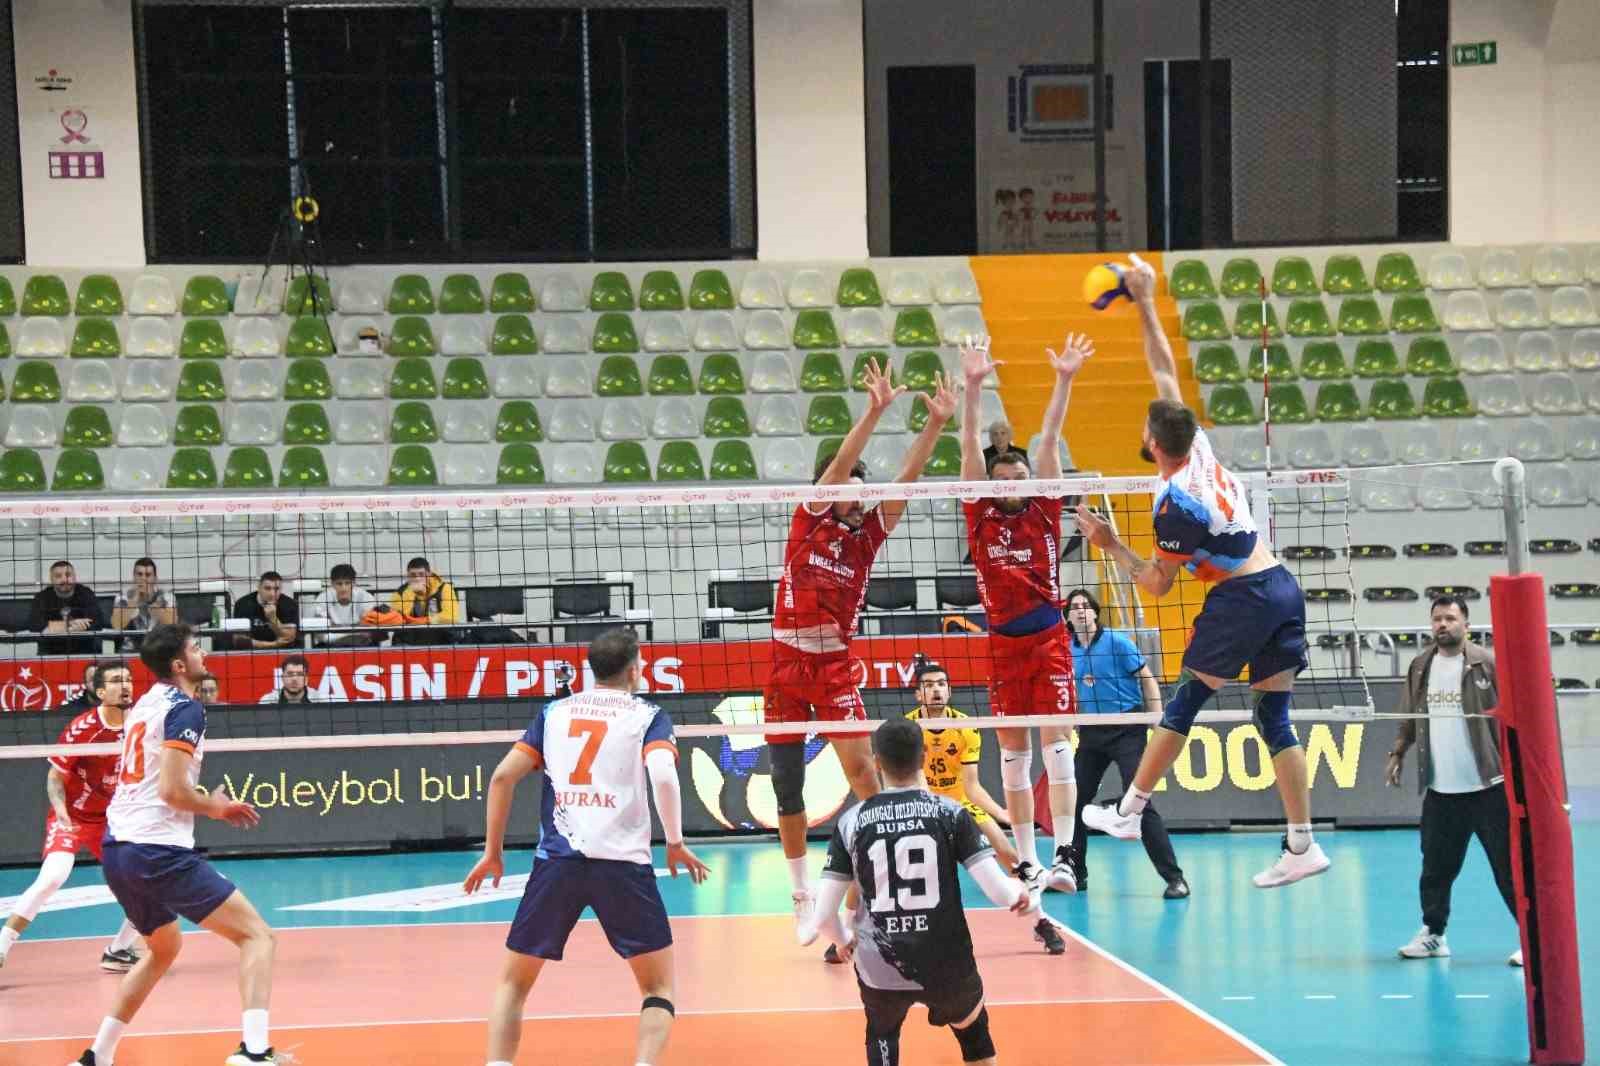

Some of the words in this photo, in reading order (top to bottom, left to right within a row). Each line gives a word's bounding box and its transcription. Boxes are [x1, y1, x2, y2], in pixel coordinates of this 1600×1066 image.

[1310, 472, 1338, 483] TVF
[873, 661, 940, 688] TV
[568, 719, 608, 785] 7
[223, 769, 404, 815] Voleybol
[420, 765, 482, 801] bu!
[555, 791, 616, 809] BURAK
[876, 819, 925, 834] BURSA
[867, 834, 941, 912] 19
[886, 914, 929, 934] EFE
